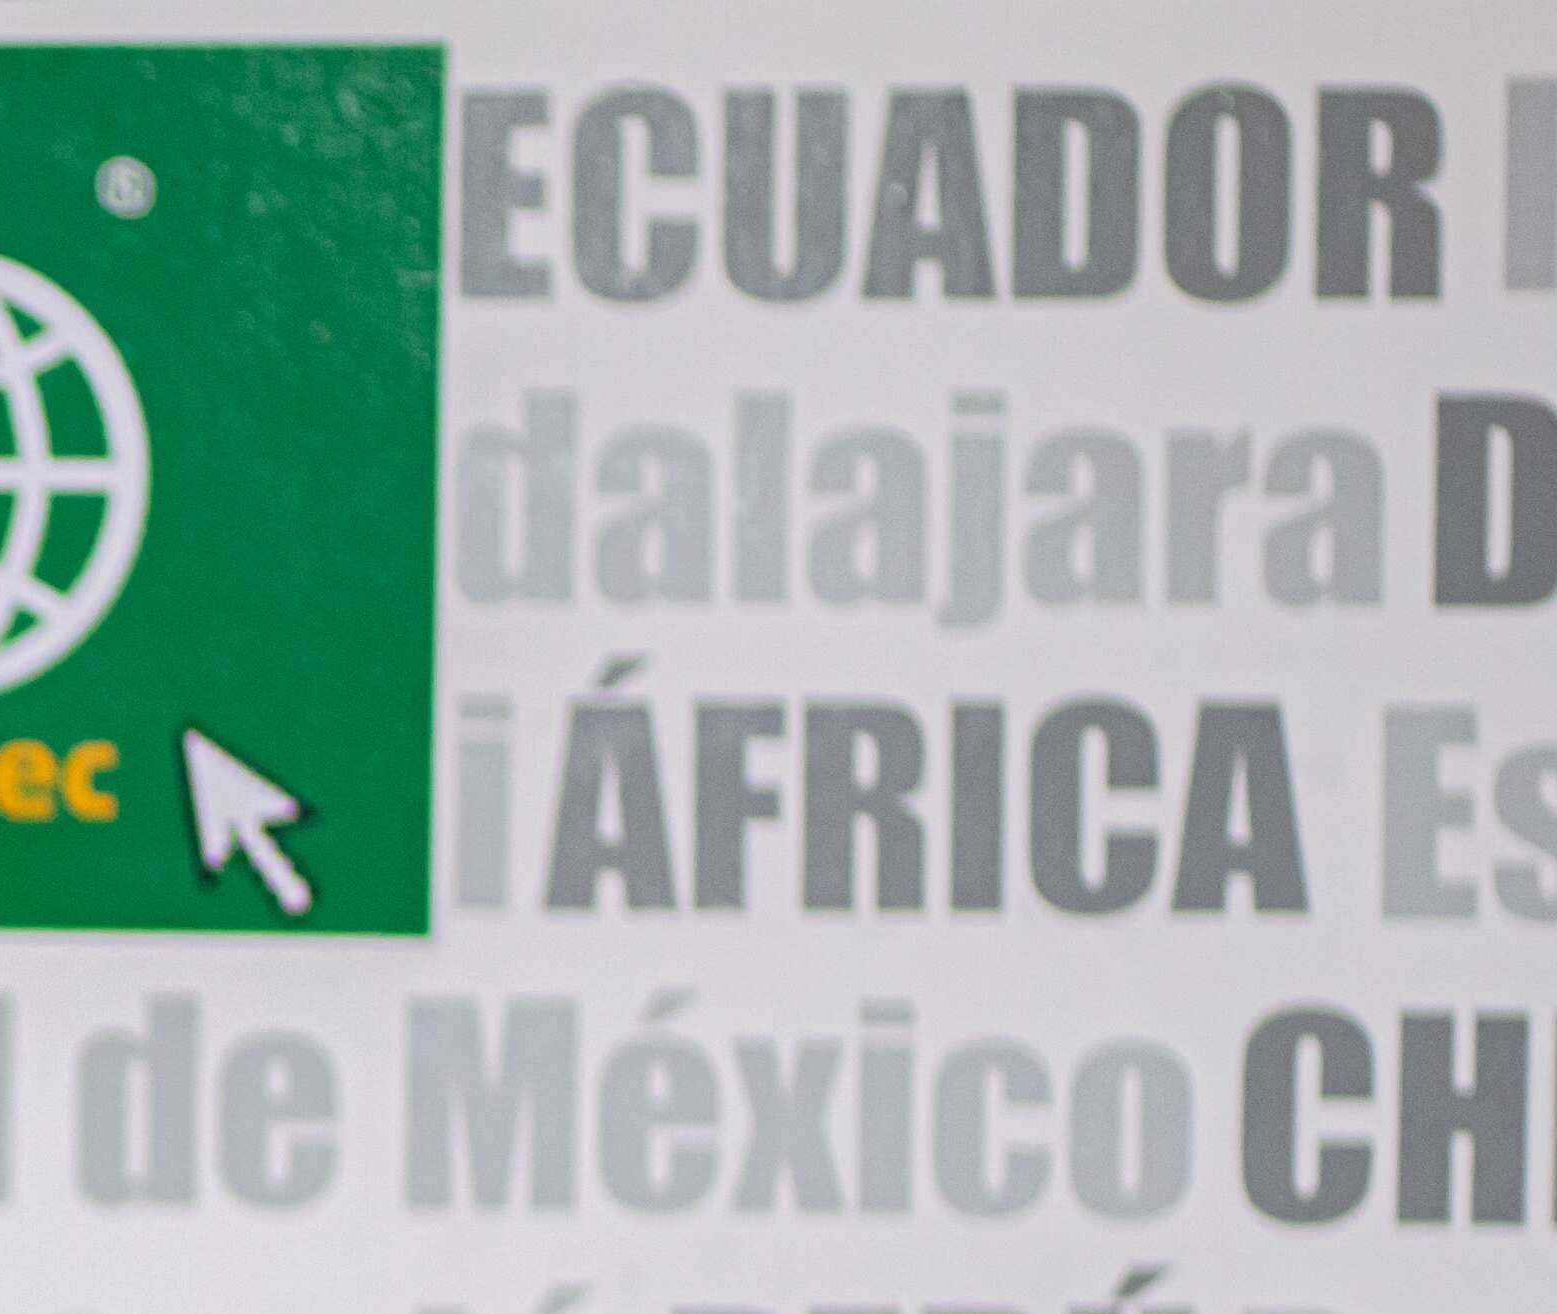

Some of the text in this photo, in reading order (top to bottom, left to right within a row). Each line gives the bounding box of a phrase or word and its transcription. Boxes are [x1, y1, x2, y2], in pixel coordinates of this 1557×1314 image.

[458, 80, 1445, 303] ECUADOR
[455, 388, 1387, 630] dalajara
[542, 650, 1312, 917] ÁFRICA
[70, 988, 338, 1208] de
[405, 990, 1193, 1220] México
[1242, 1005, 1557, 1228] CH
